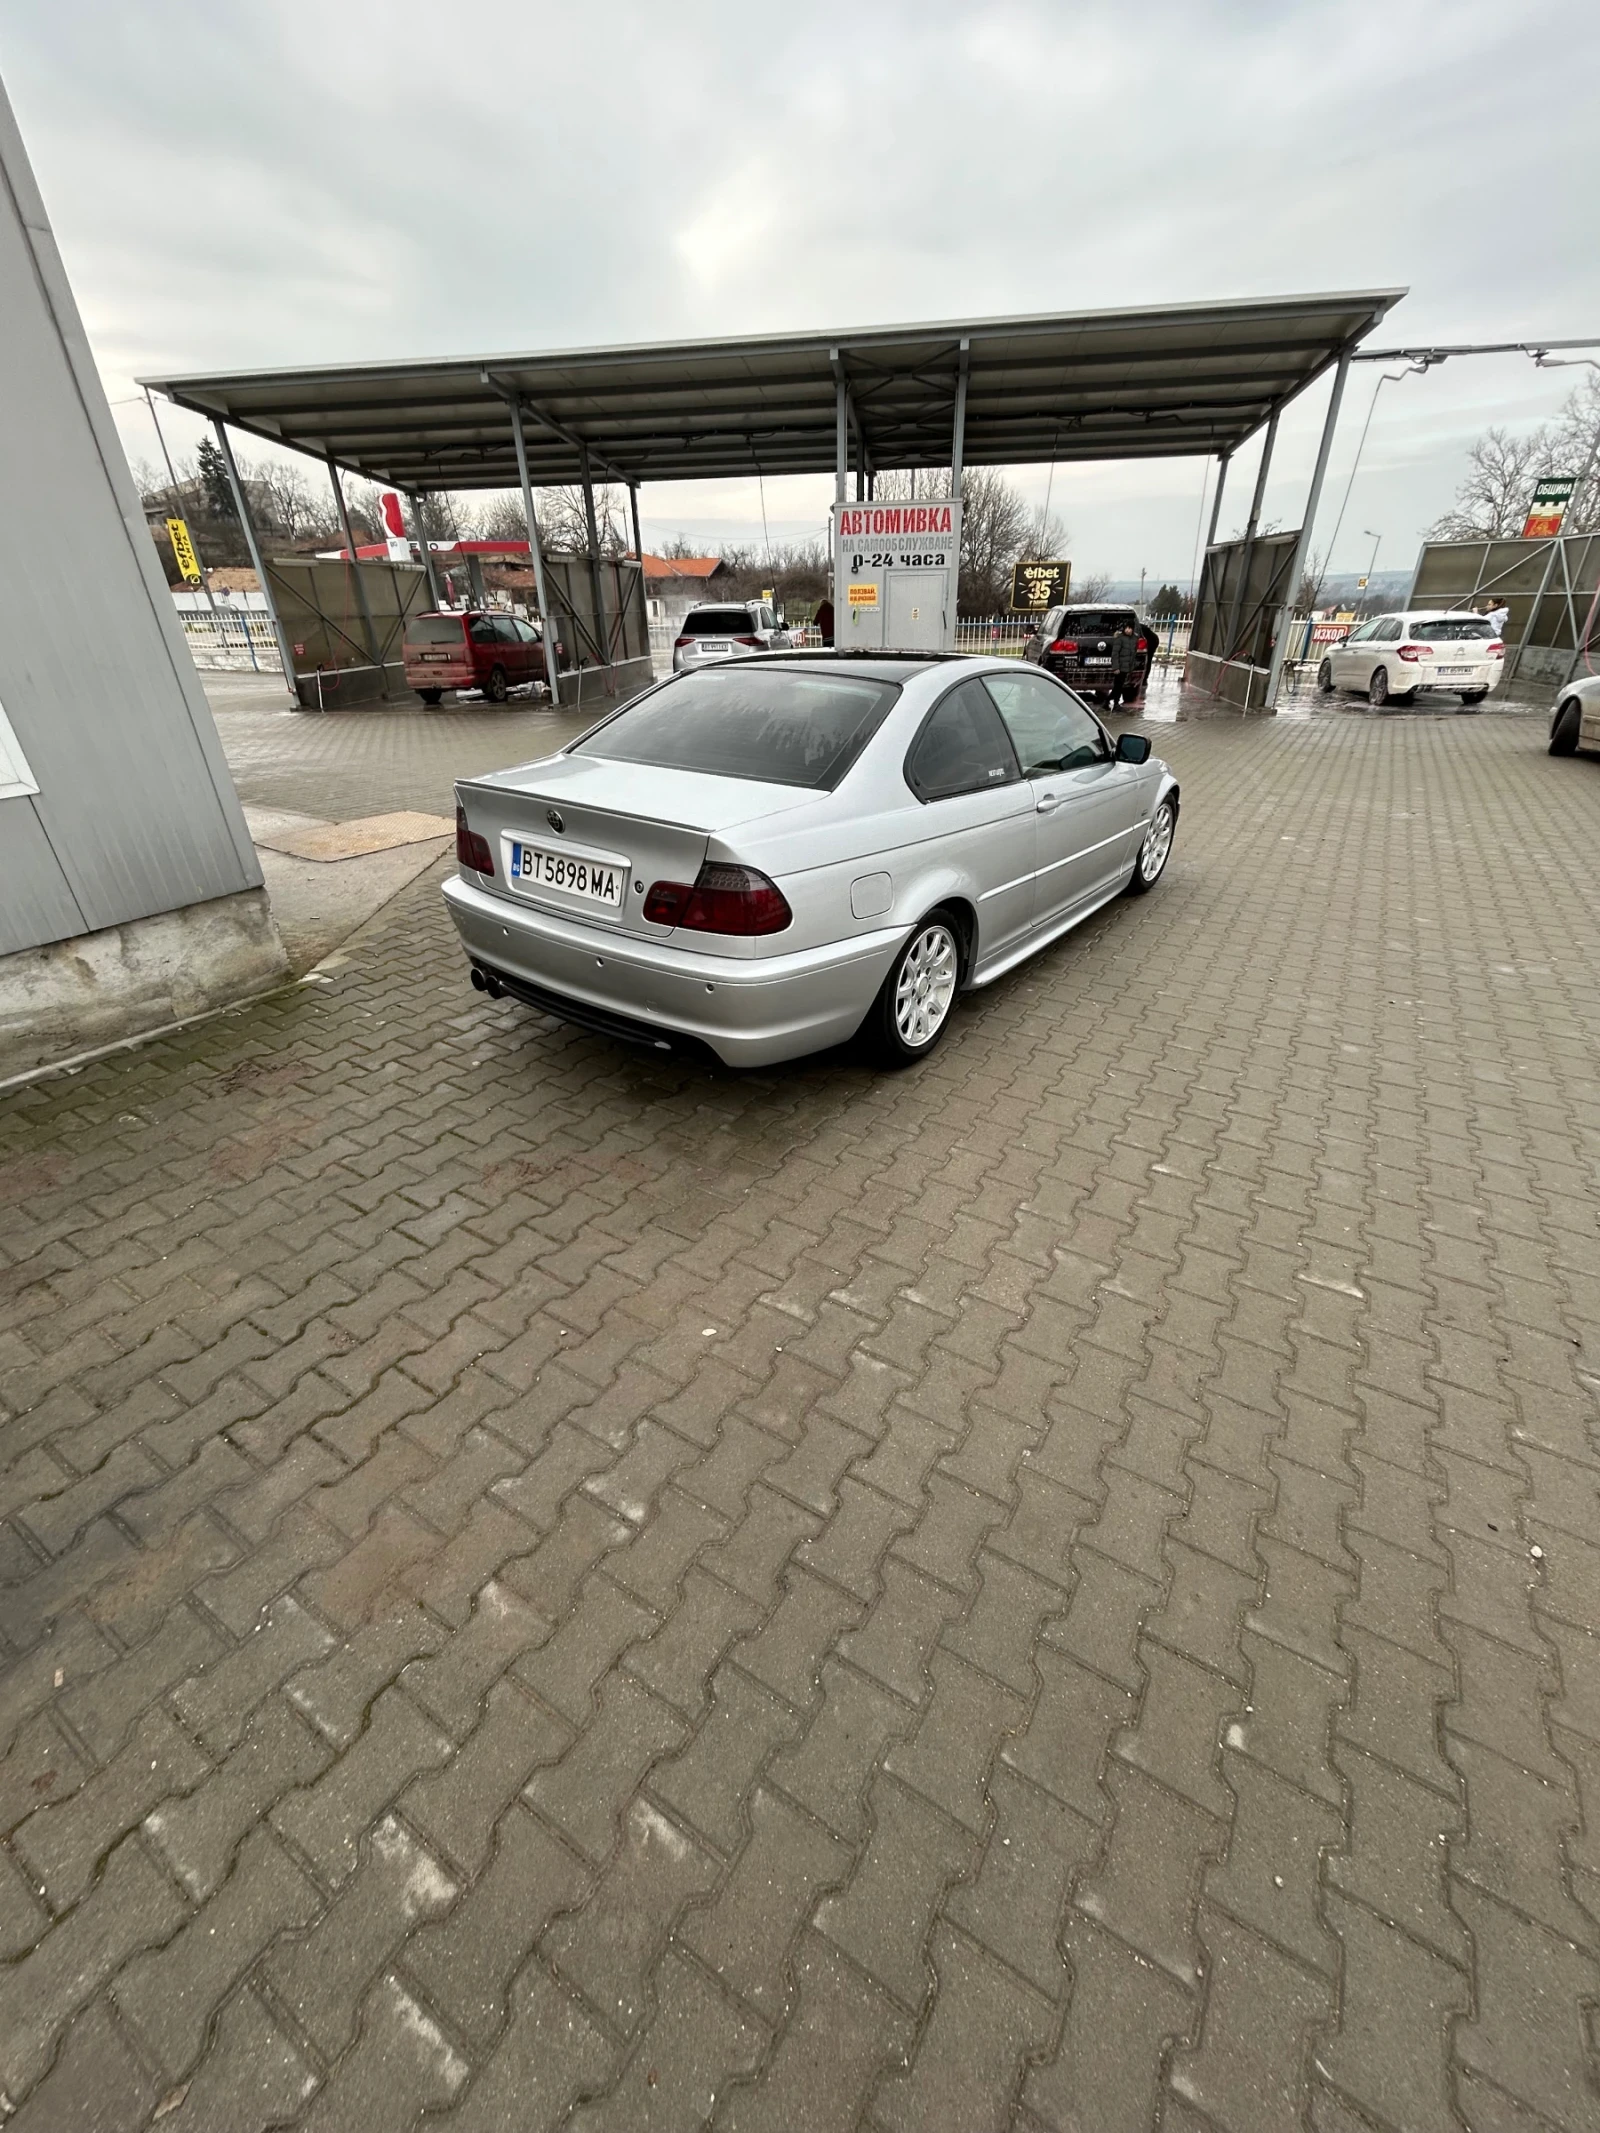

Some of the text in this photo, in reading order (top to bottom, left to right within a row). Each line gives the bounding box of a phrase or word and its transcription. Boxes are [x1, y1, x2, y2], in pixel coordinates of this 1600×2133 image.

[1537, 483, 1572, 495] ОБЩИНА
[840, 507, 952, 535] АВТОМИВКА
[171, 523, 190, 570] efbet
[409, 543, 438, 551] EO
[842, 537, 953, 553] НА САМООБСЛУЖВАНЕ
[900, 553, 945, 566] часа
[1024, 567, 1060, 579] efbet
[1027, 580, 1052, 600] 35
[1313, 628, 1345, 641] ИЗХОД
